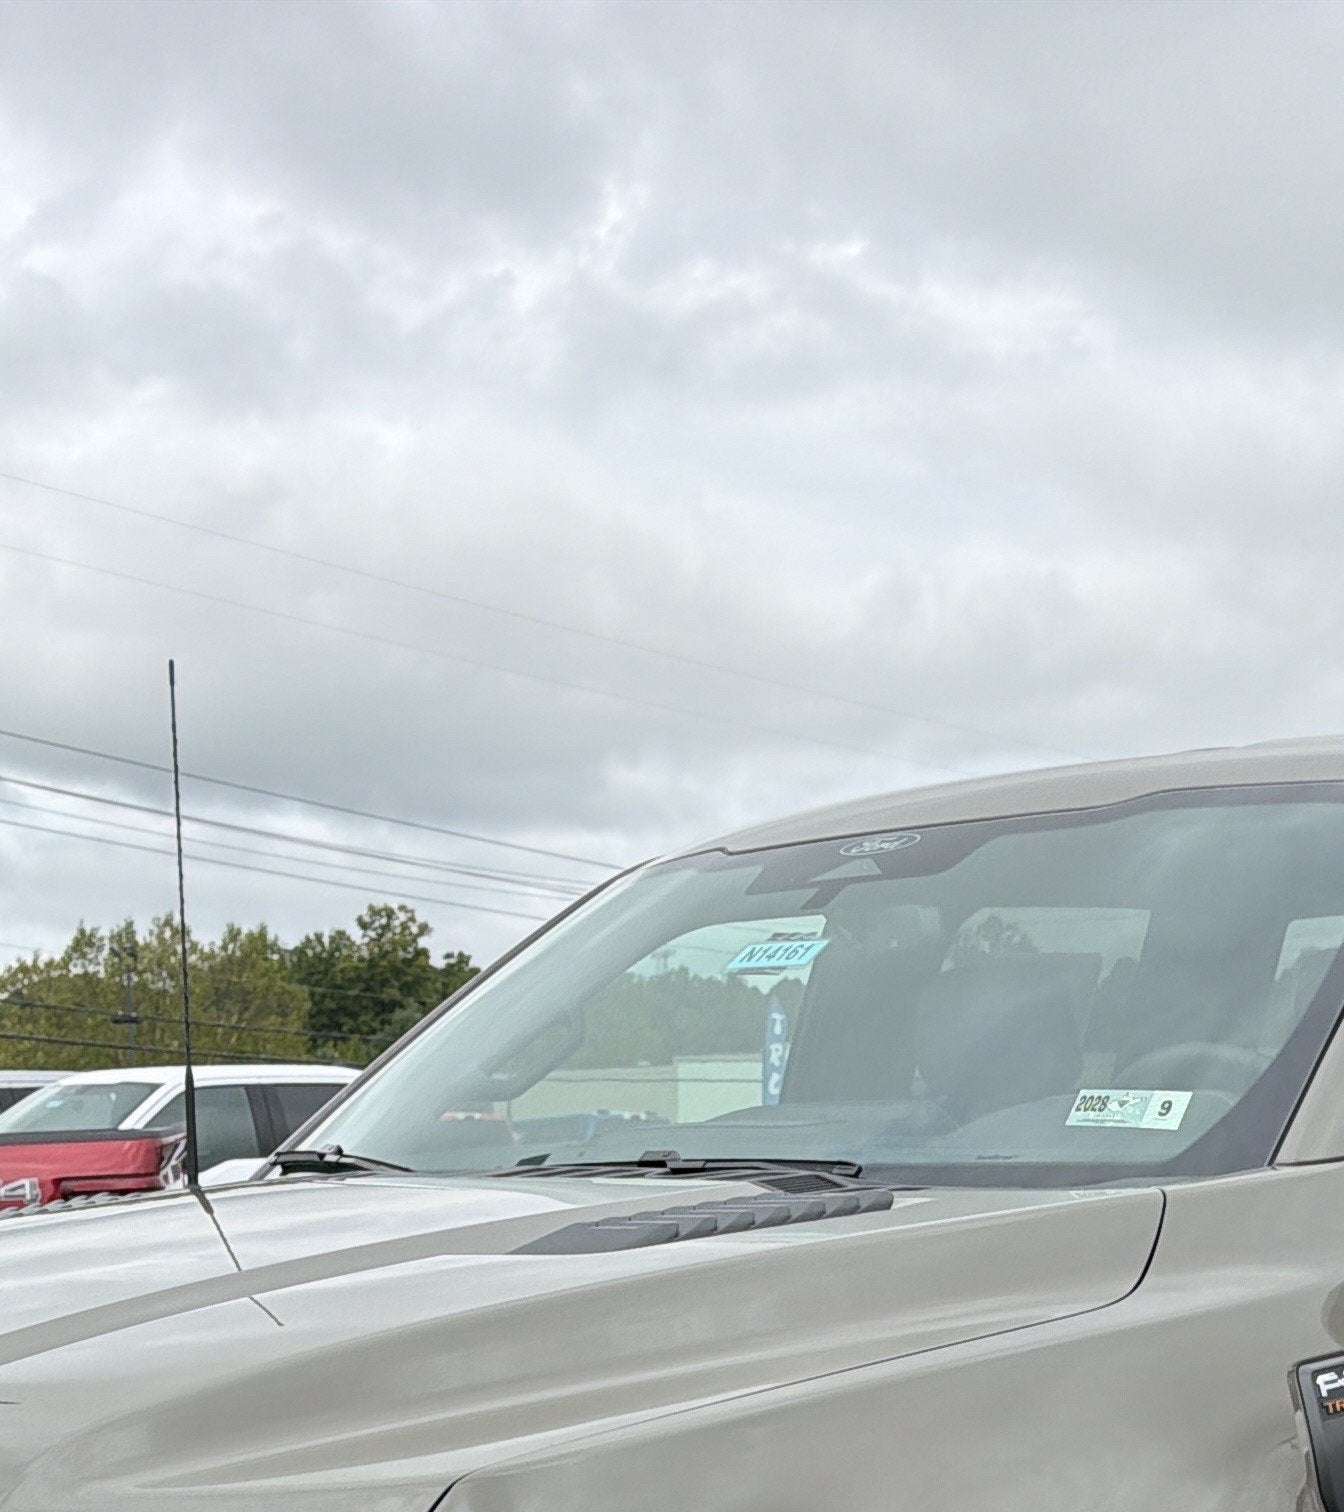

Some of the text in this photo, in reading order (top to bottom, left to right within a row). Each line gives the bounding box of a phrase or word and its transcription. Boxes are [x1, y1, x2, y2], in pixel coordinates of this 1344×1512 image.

[738, 942, 816, 964] N14161
[1074, 1094, 1173, 1117] 2028 9
